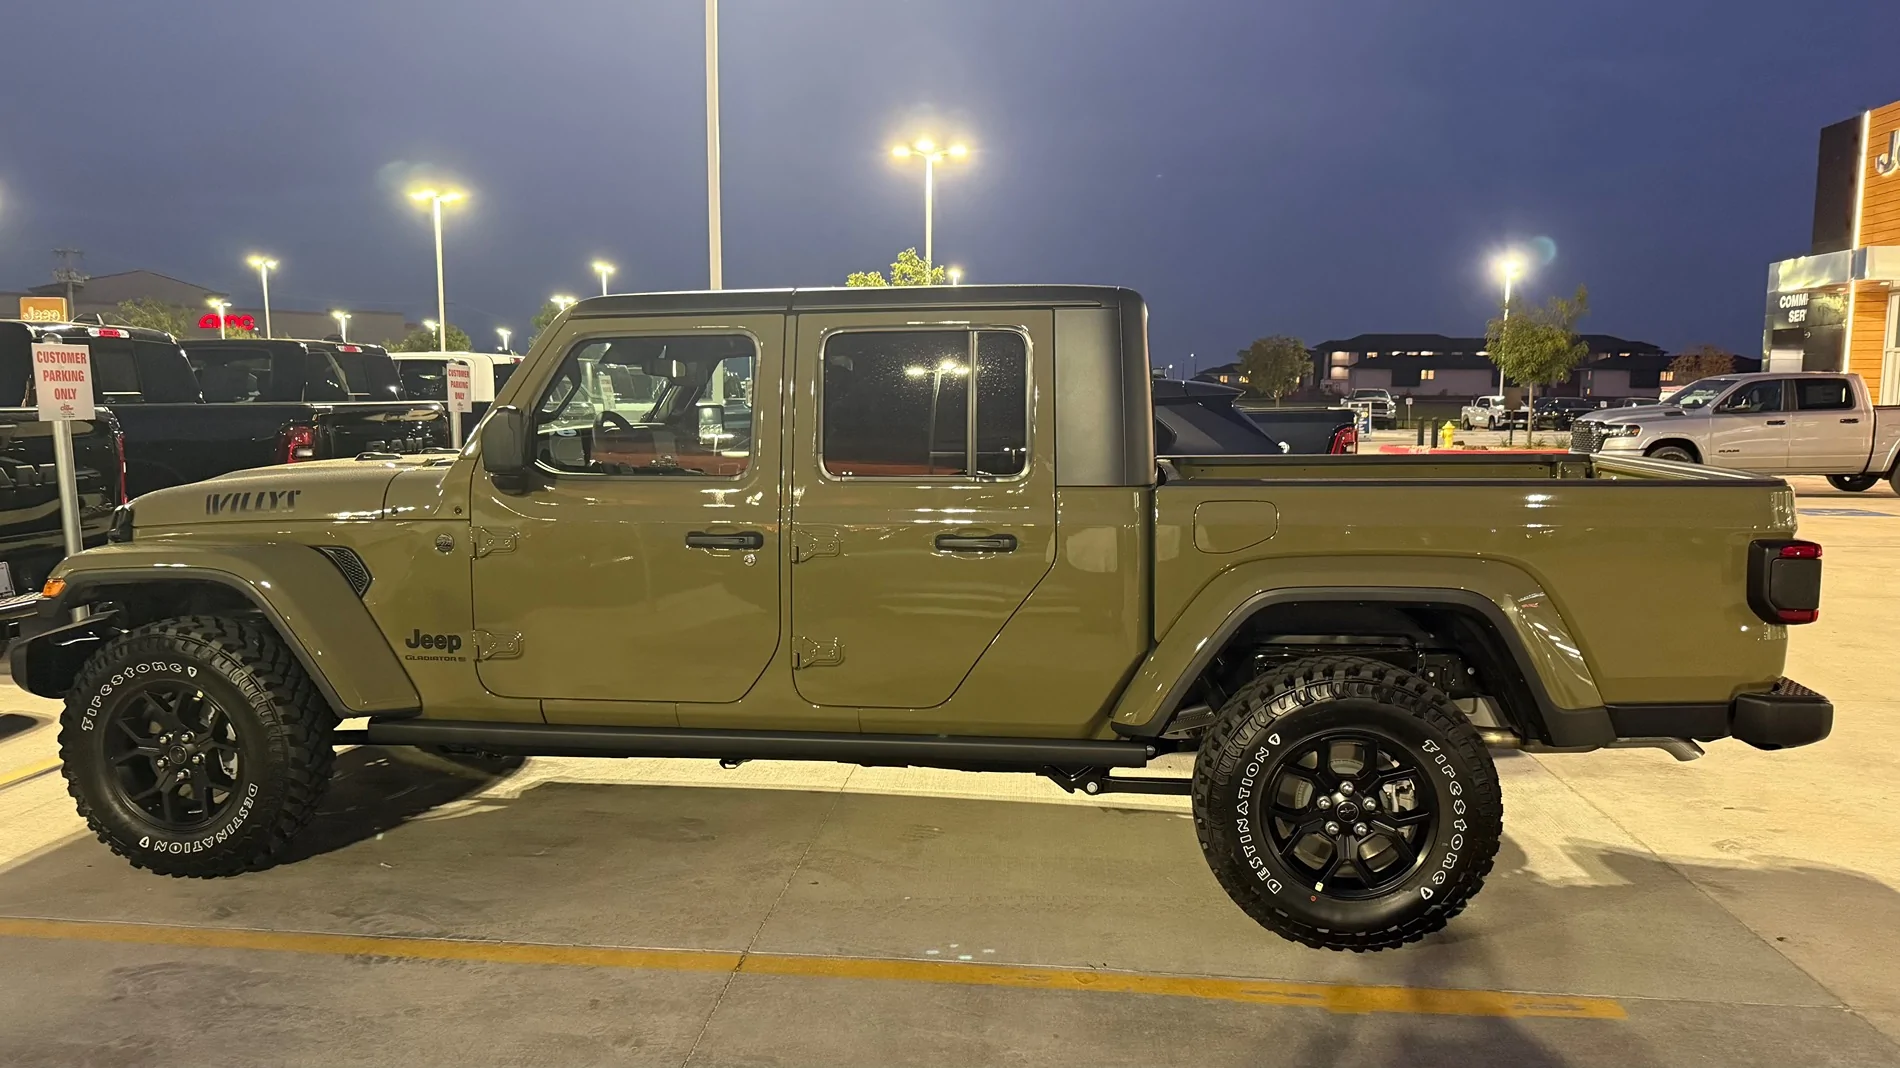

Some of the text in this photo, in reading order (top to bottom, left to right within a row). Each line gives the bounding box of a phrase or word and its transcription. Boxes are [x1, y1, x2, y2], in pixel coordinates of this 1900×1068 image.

[1779, 293, 1809, 308] COMM
[1788, 309, 1808, 323] SER
[36, 351, 87, 364] CUSTOMER
[43, 370, 85, 382] PARKING
[448, 369, 470, 378] CUSTOMER
[450, 381, 468, 389] PARKING
[54, 388, 77, 400] ONLY
[455, 392, 465, 400] ONLY
[206, 490, 301, 515] WILLYS
[405, 628, 462, 654] Jeep
[405, 654, 457, 662] GLADIATOR
[153, 782, 259, 854] DESTINATION
[1237, 747, 1283, 895] DESTINATION
